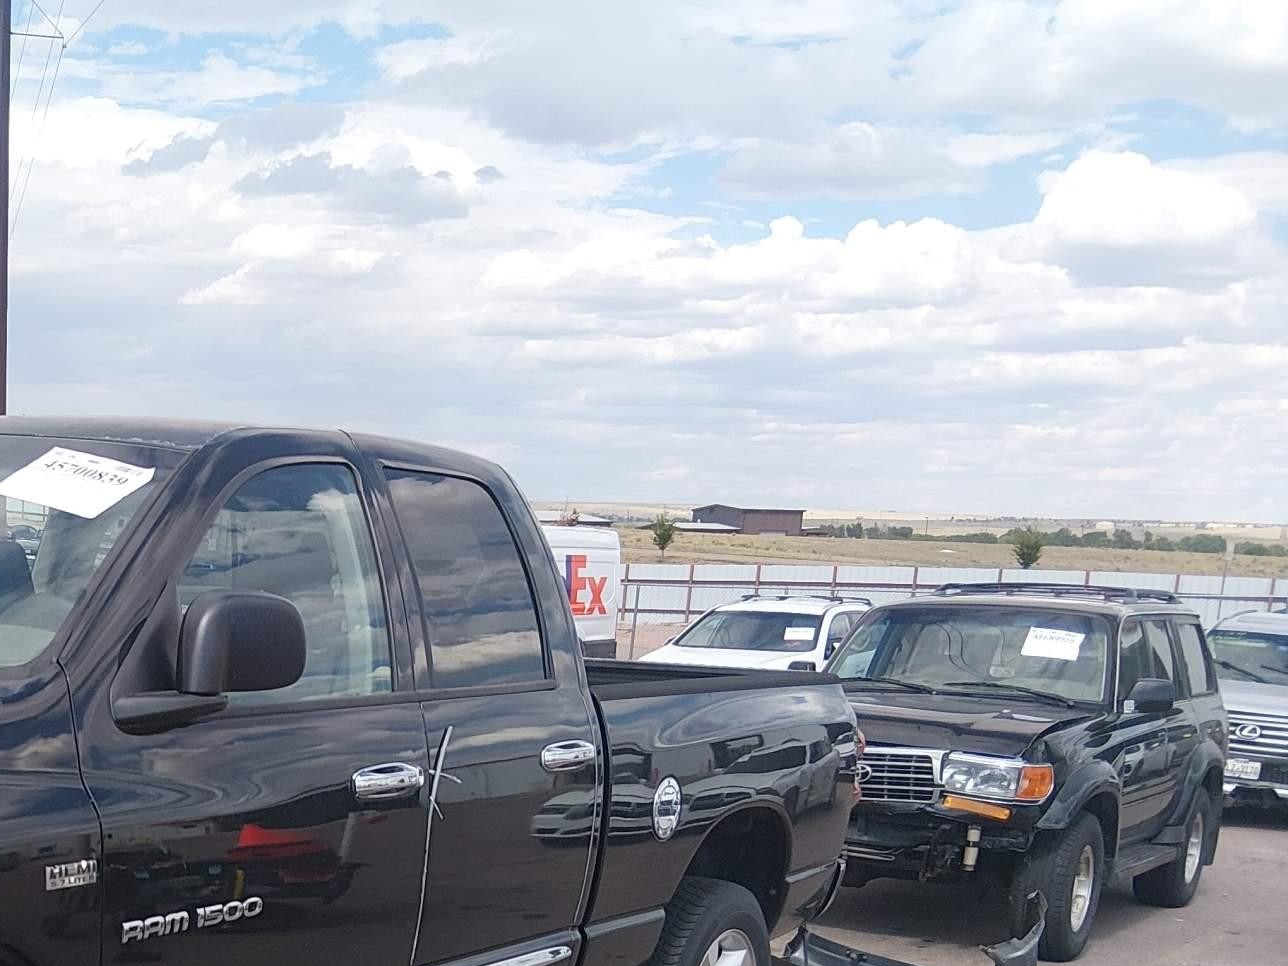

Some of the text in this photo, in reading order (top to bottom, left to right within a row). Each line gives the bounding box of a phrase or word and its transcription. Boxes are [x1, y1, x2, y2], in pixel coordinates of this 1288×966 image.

[50, 861, 96, 879] HEMI
[121, 896, 264, 944] RAM 1500
